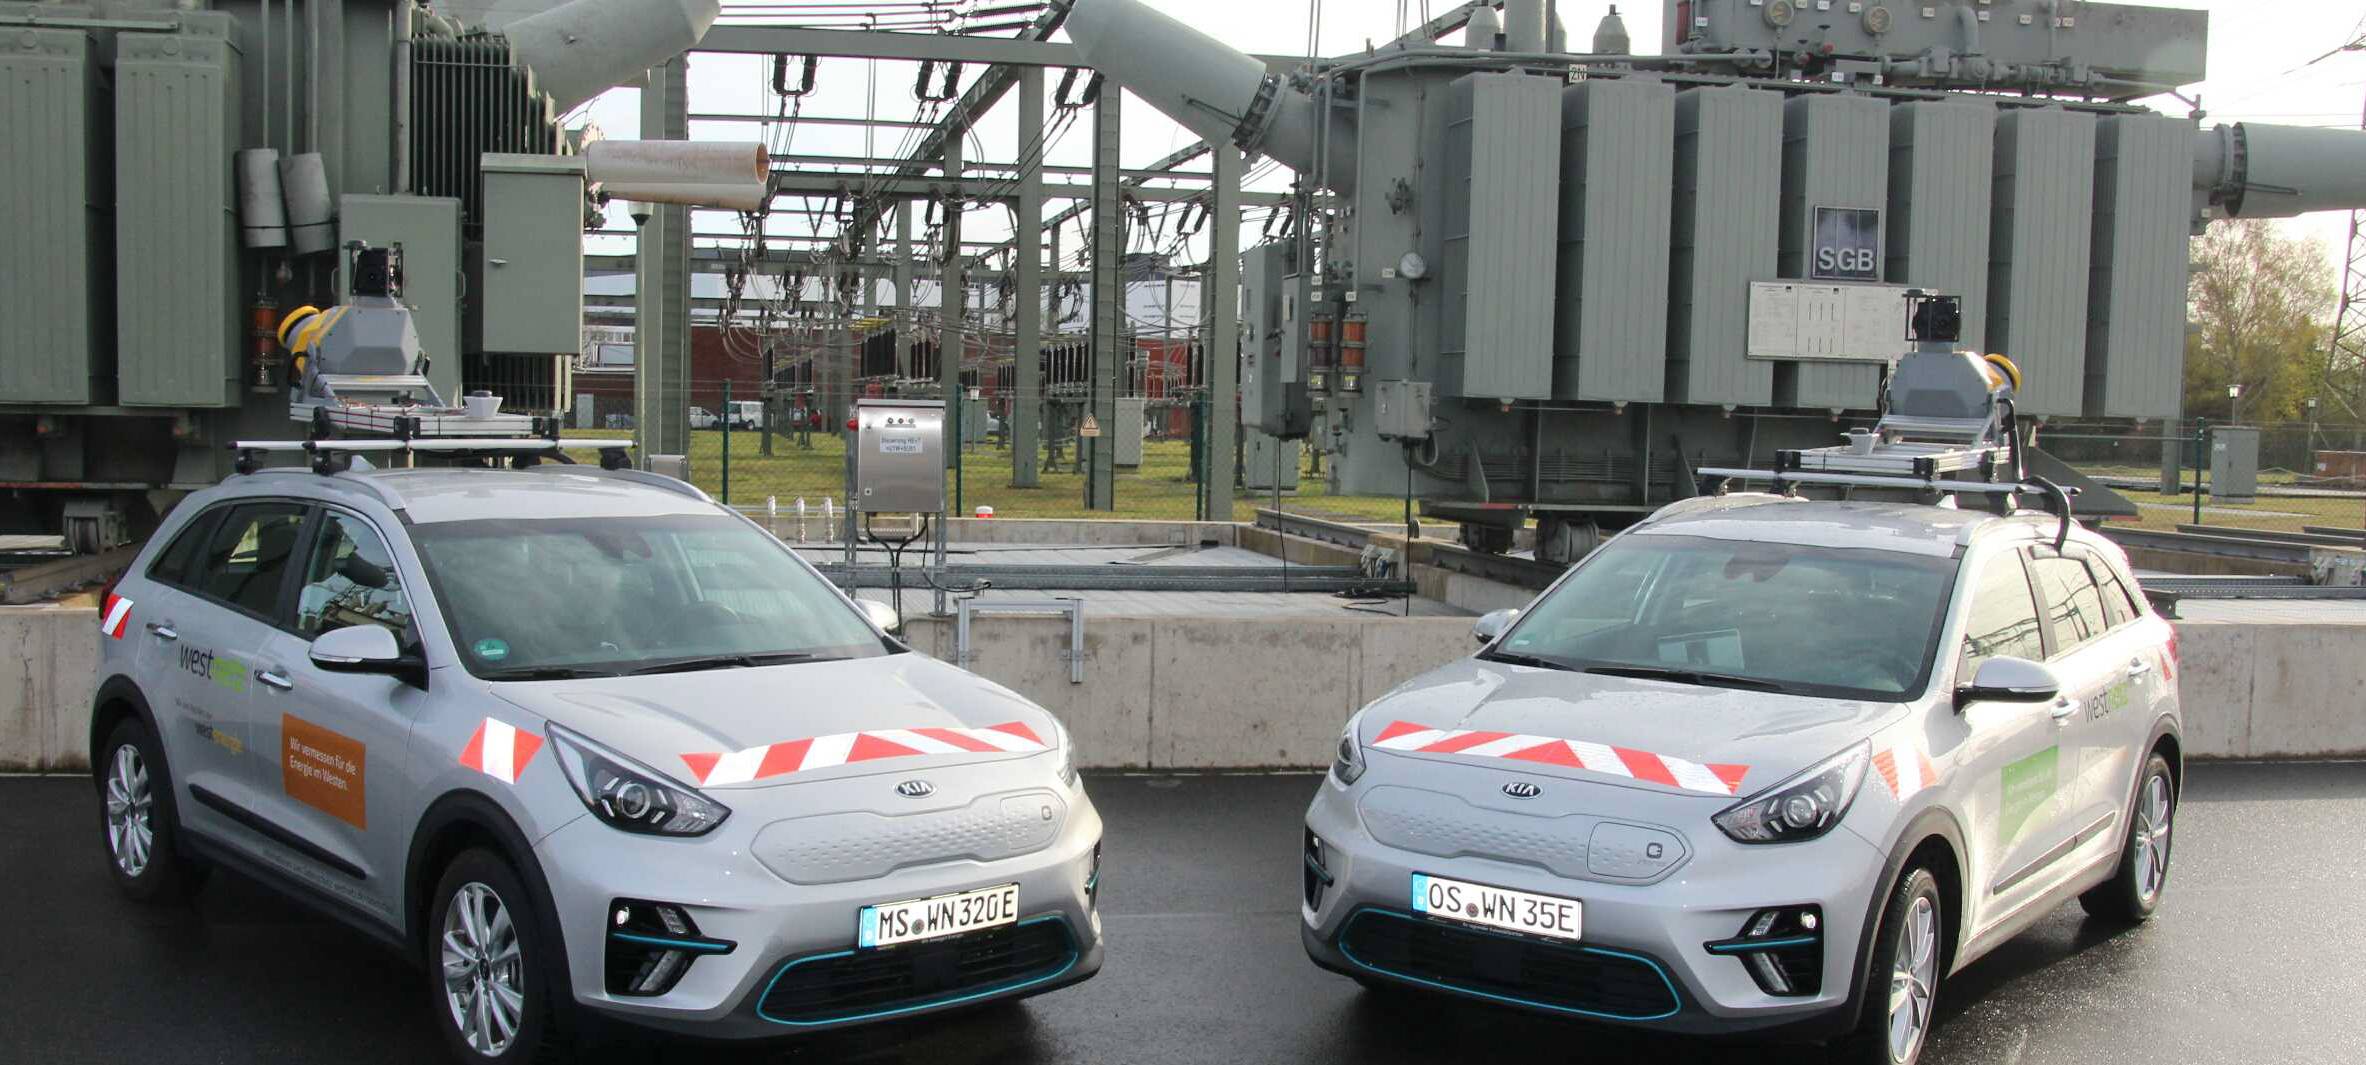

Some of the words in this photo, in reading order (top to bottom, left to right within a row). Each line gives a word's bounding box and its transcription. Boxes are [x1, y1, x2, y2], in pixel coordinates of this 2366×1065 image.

[1818, 246, 1874, 272] SGB
[180, 644, 247, 693] west
[2083, 682, 2129, 723] west
[289, 737, 301, 752] Wir
[902, 780, 932, 795] KIA
[1506, 783, 1535, 796] KIA
[878, 908, 909, 940] MS
[928, 901, 956, 931] WN
[1429, 883, 1461, 912] OS
[1482, 891, 1516, 923] WN
[1523, 898, 1575, 933] 35E
